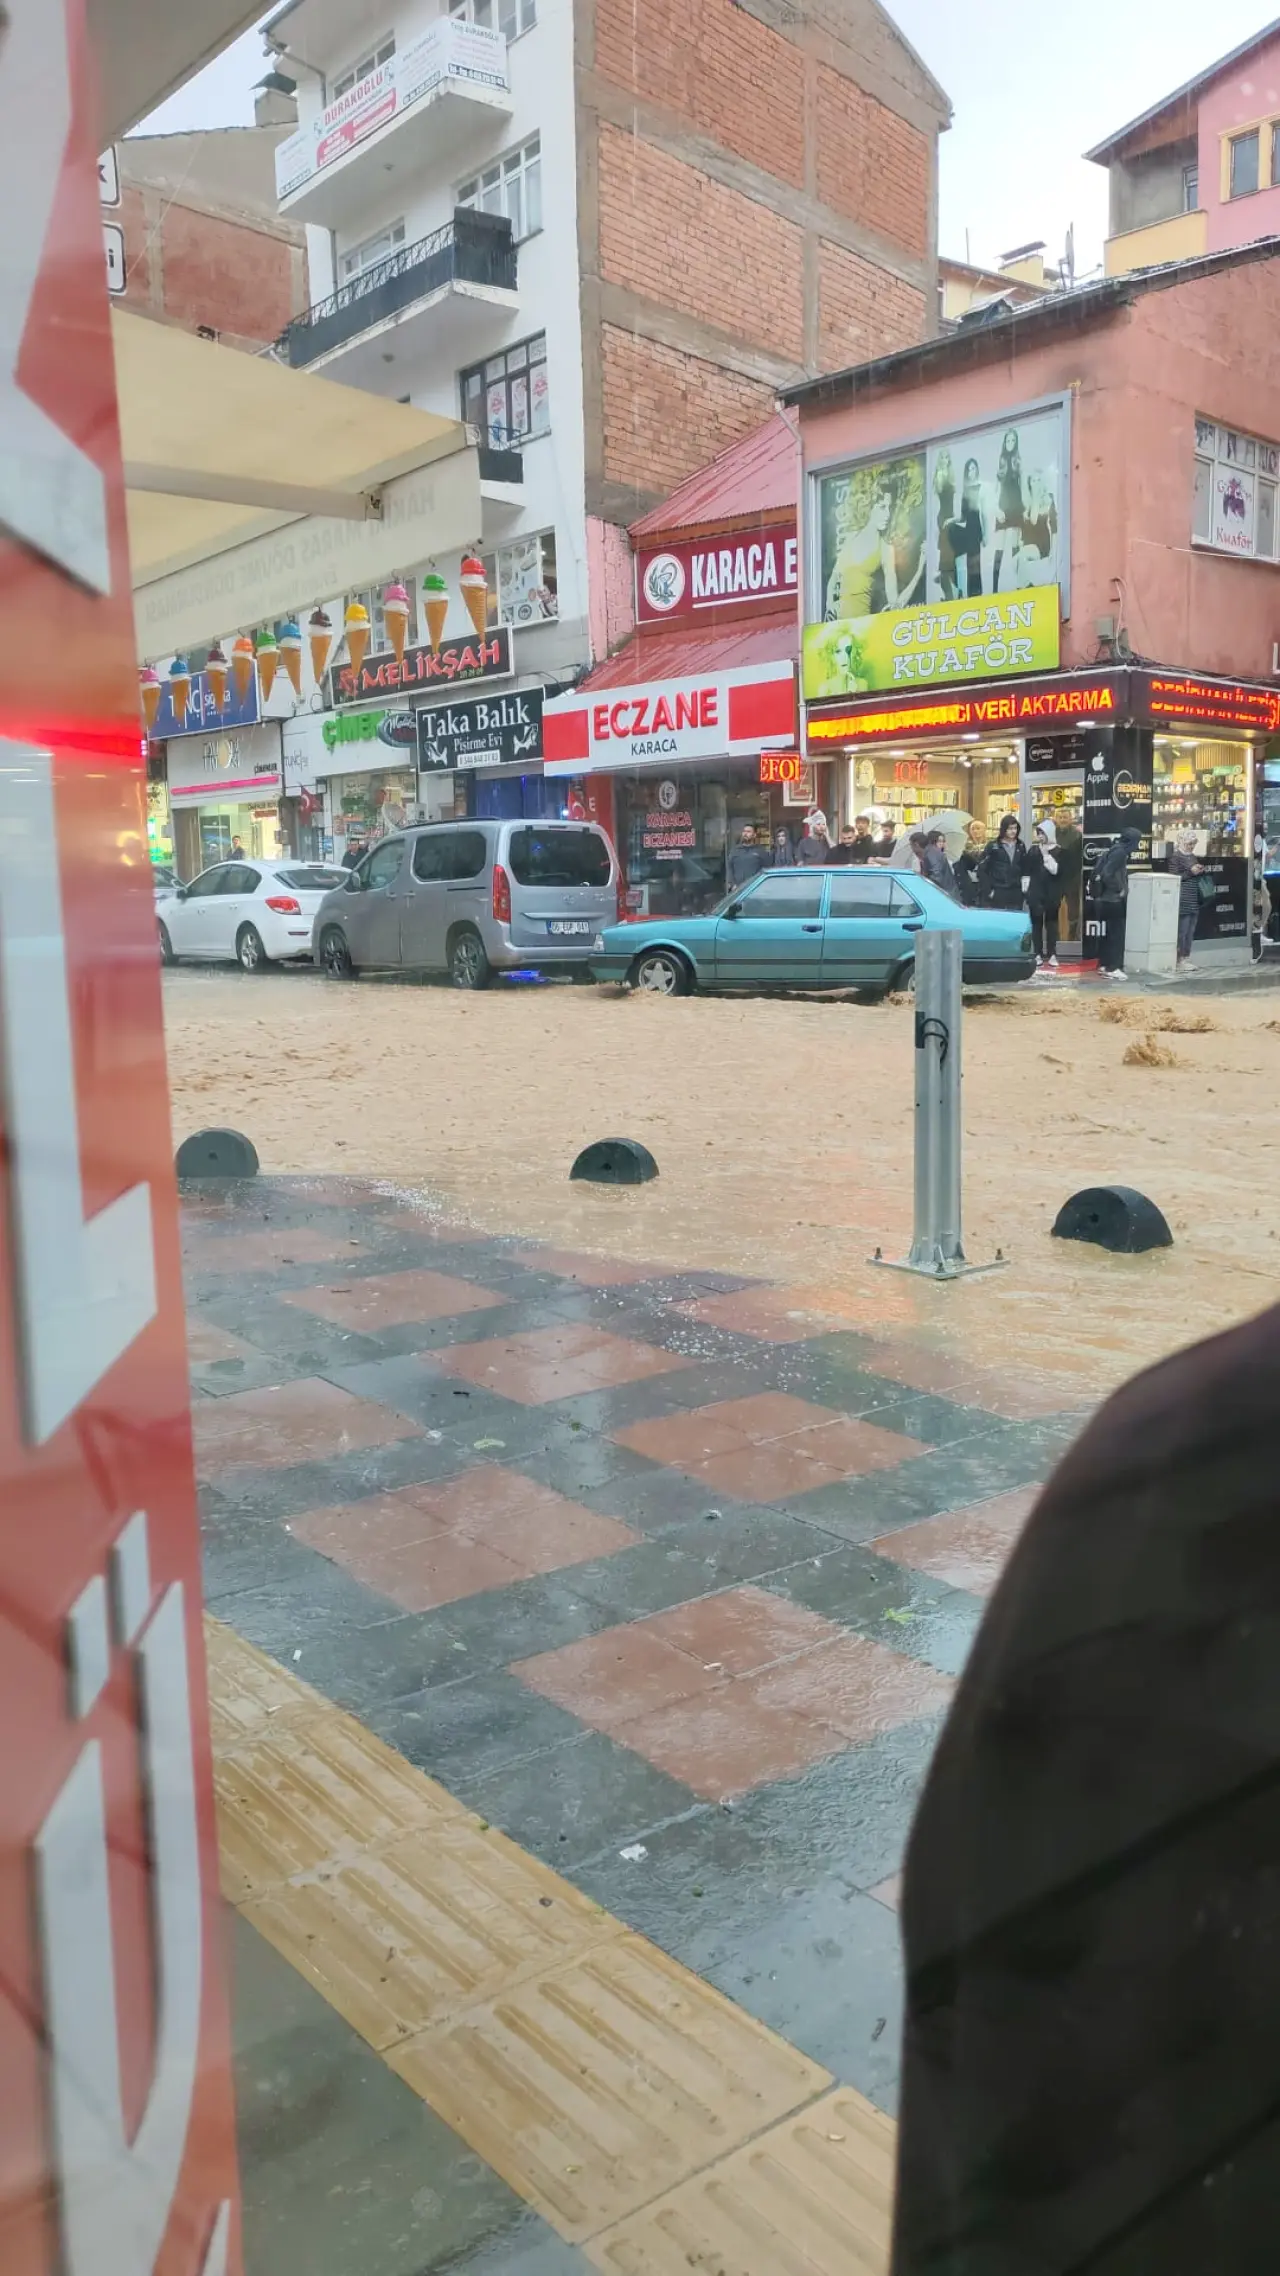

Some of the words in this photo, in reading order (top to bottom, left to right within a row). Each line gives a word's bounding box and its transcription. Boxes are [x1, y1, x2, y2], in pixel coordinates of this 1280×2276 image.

[324, 71, 384, 126] DURAKOĞLU
[691, 542, 777, 598] KARACA
[891, 601, 1036, 647] GÜLCAN
[893, 635, 1033, 680] KUAFÖR
[423, 709, 471, 739] Taka
[475, 697, 531, 730] Balık
[593, 687, 719, 741] ECZANE
[974, 693, 1017, 721] VERİ
[1020, 687, 1113, 716] AKTARMA
[454, 736, 487, 754] Pişirme
[488, 732, 503, 748] Evi
[631, 738, 678, 756] KARACA
[1087, 773, 1109, 784] Apple
[643, 828, 696, 848] ECZANESİ
[646, 812, 692, 828] KARACA
